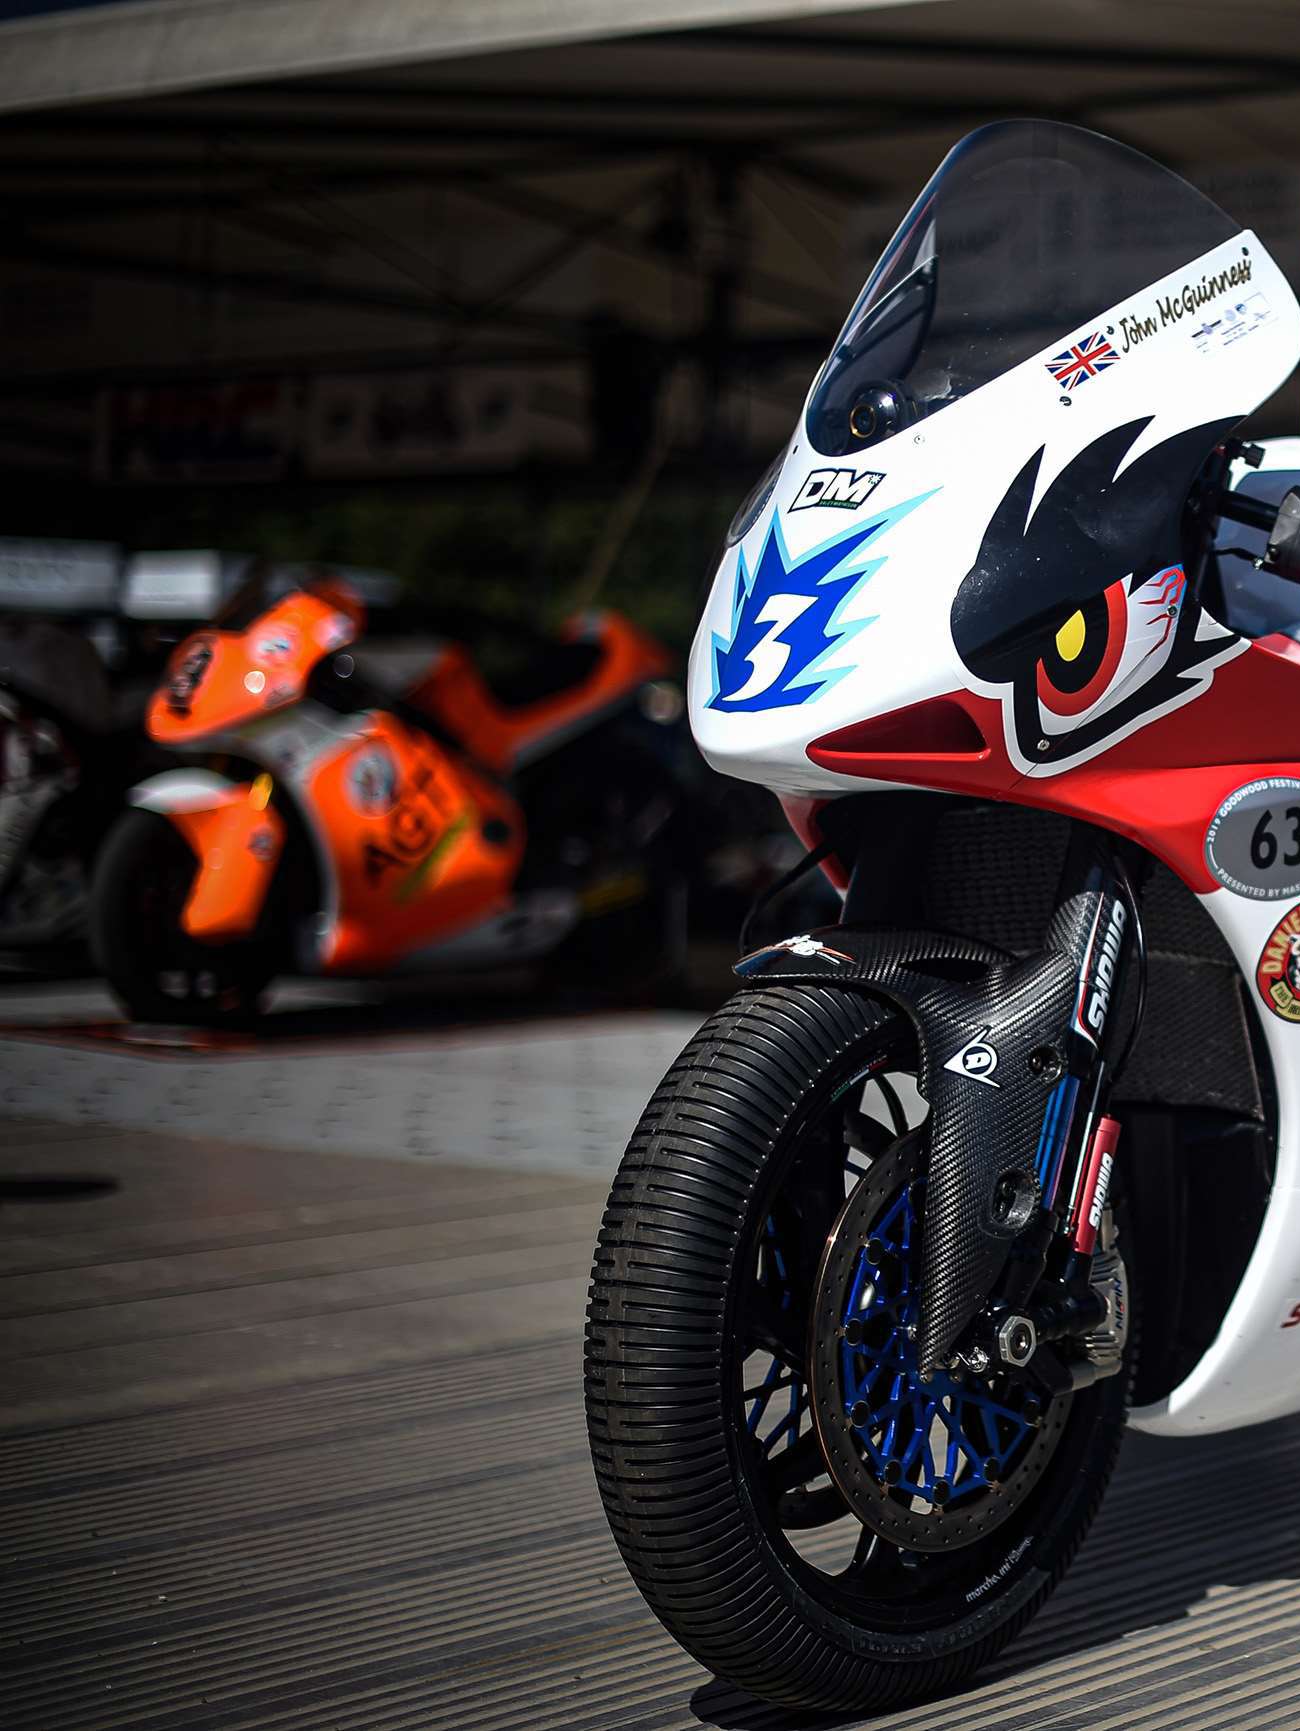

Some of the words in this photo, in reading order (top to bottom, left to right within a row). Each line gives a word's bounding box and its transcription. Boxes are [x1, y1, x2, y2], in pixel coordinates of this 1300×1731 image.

[1119, 315, 1158, 353] John
[1155, 258, 1252, 327] McGuinness
[787, 467, 887, 513] DM
[721, 593, 819, 702] 3
[1206, 817, 1222, 843] 2019
[1219, 779, 1269, 818] GOODWOOD
[1217, 867, 1266, 897] PRESENTED
[1267, 887, 1281, 898] BY
[1087, 899, 1128, 1036] SHOWA
